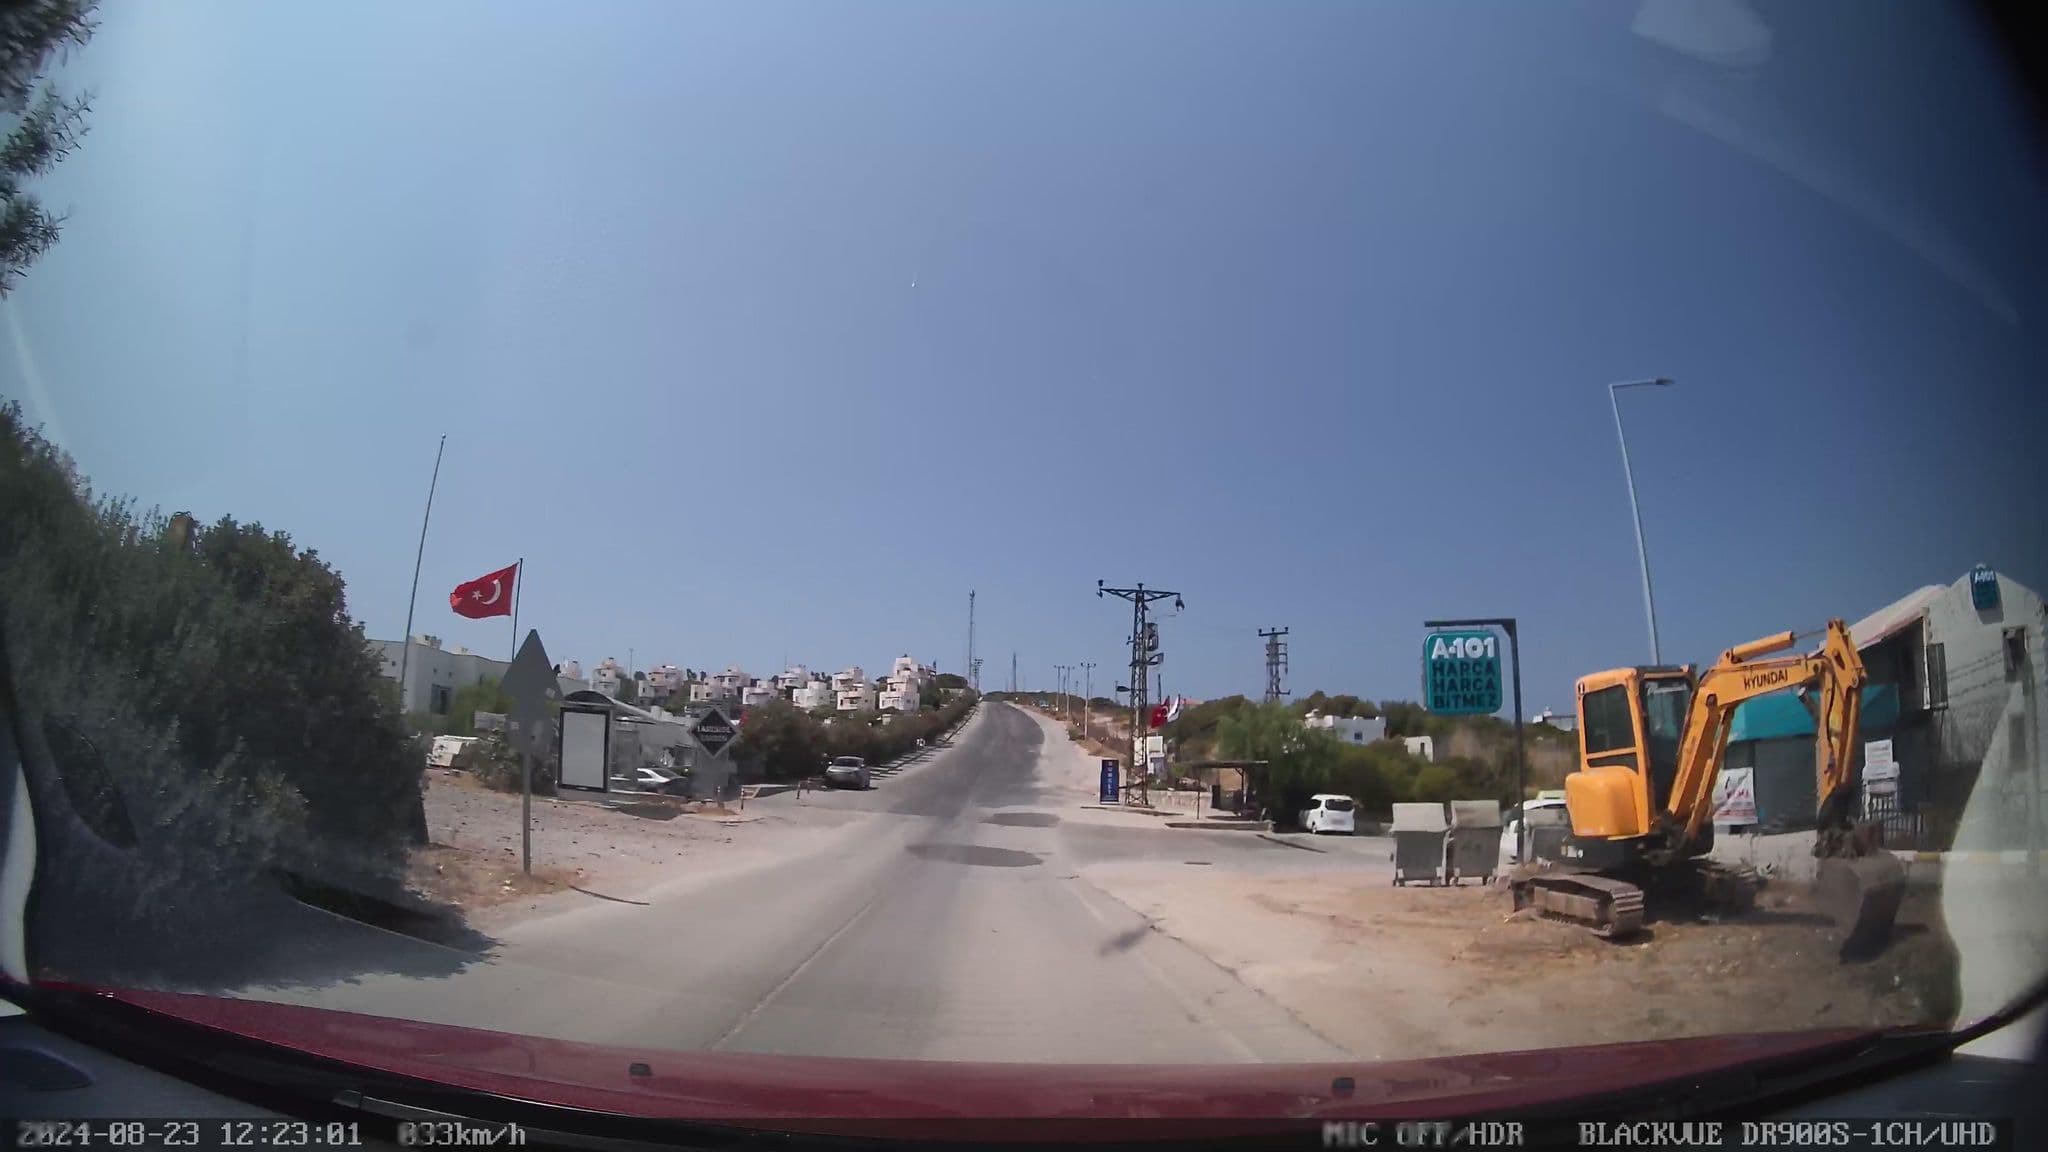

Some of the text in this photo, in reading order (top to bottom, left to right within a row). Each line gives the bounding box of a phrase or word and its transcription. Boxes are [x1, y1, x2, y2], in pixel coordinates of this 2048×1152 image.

[1432, 661, 1495, 677] HARCA
[1433, 678, 1495, 693] HARCA
[1743, 668, 1788, 690] HYUNDAI
[1434, 694, 1497, 709] BITMEZ
